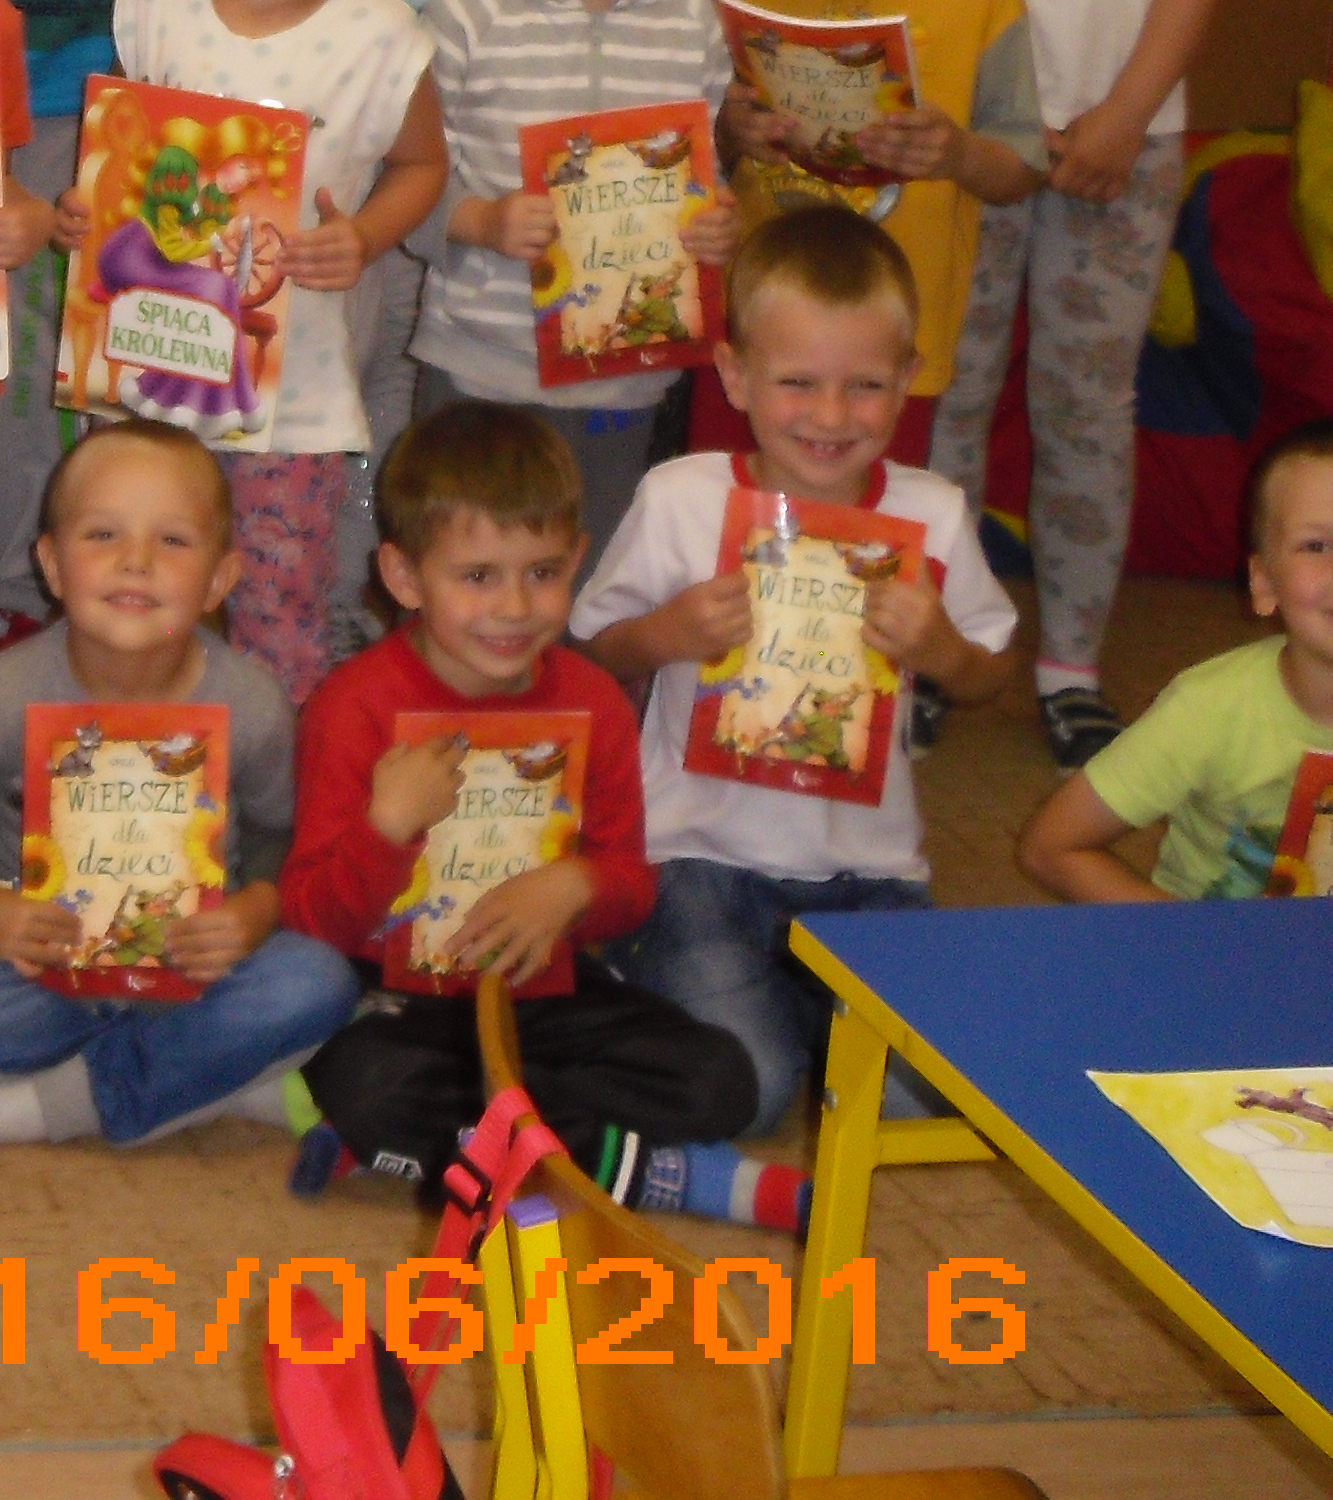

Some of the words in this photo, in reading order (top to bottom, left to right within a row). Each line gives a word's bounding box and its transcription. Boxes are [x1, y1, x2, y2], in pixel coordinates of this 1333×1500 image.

[582, 235, 673, 272] dzieci
[110, 326, 231, 374] KRÓLEWNA
[757, 628, 856, 678] dzieci
[112, 819, 147, 845] dla
[76, 837, 175, 882] dzieci
